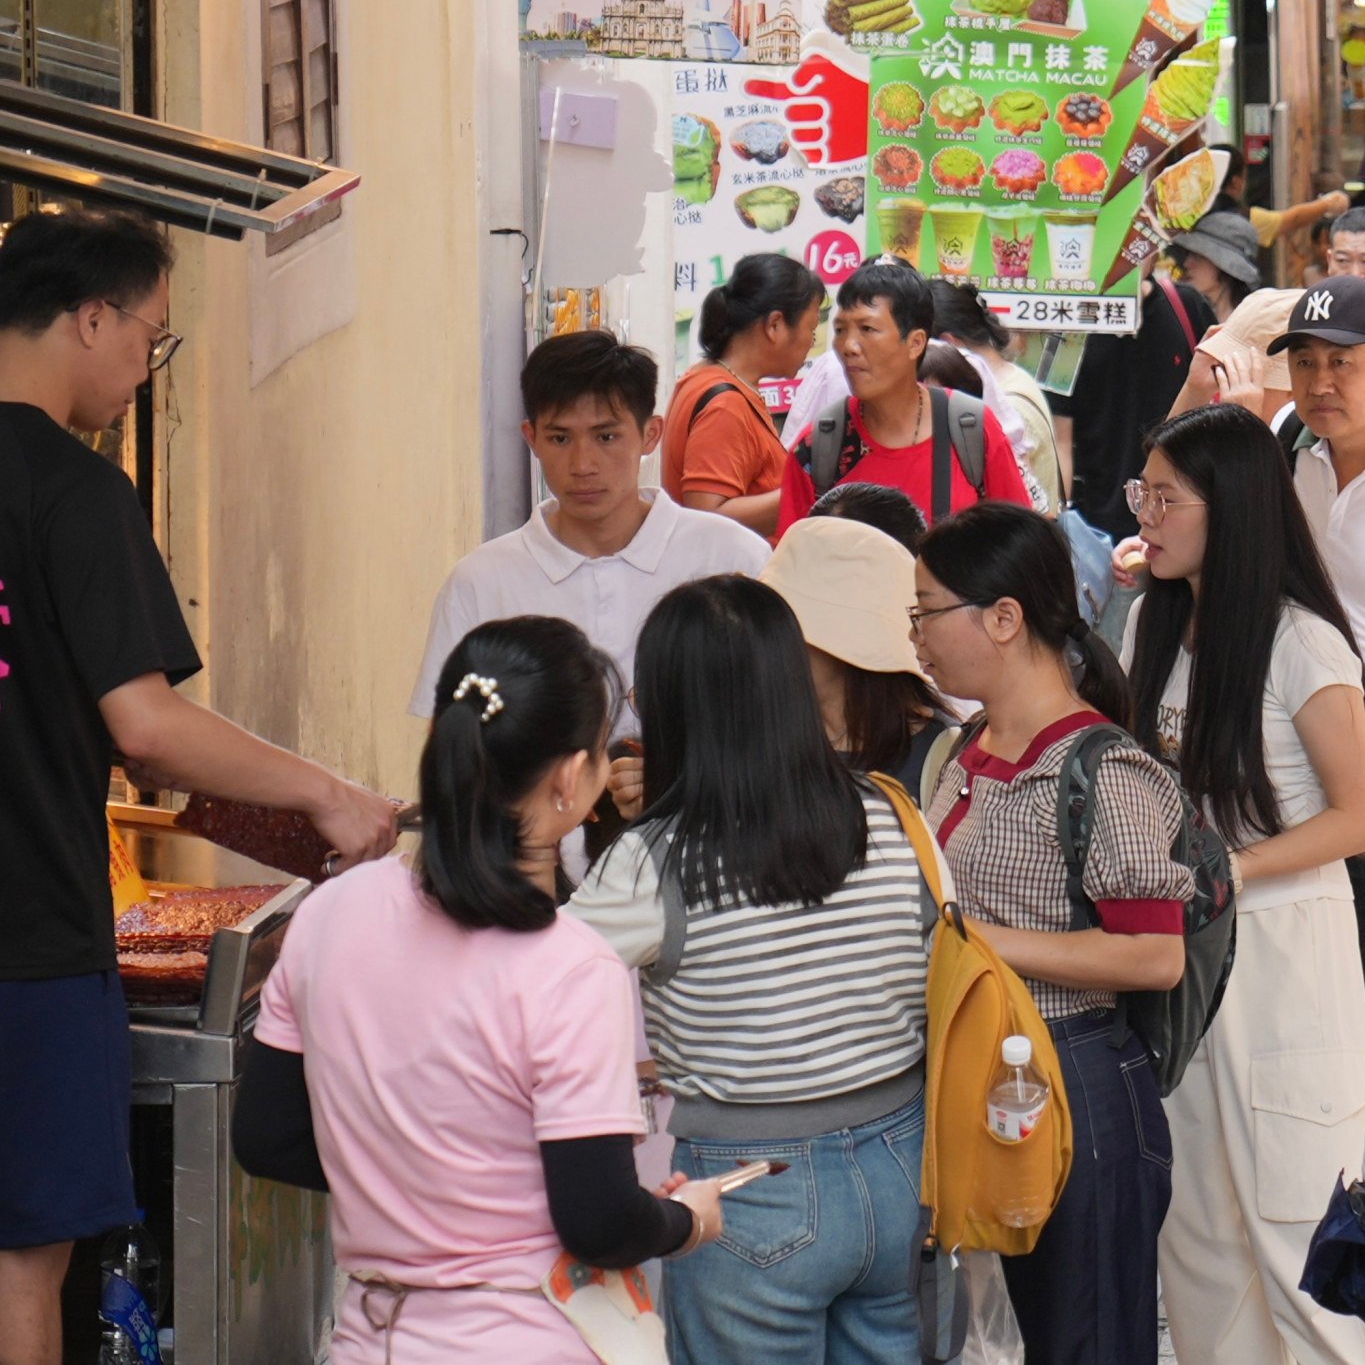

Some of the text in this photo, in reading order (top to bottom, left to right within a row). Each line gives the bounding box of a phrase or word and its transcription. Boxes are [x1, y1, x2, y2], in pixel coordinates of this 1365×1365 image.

[969, 41, 1110, 71] 澳門抹茶
[969, 68, 1108, 86] MATCHA MACAU
[808, 240, 859, 274] 16元
[1016, 300, 1128, 325] 28米雪糕
[1304, 290, 1334, 321] NY
